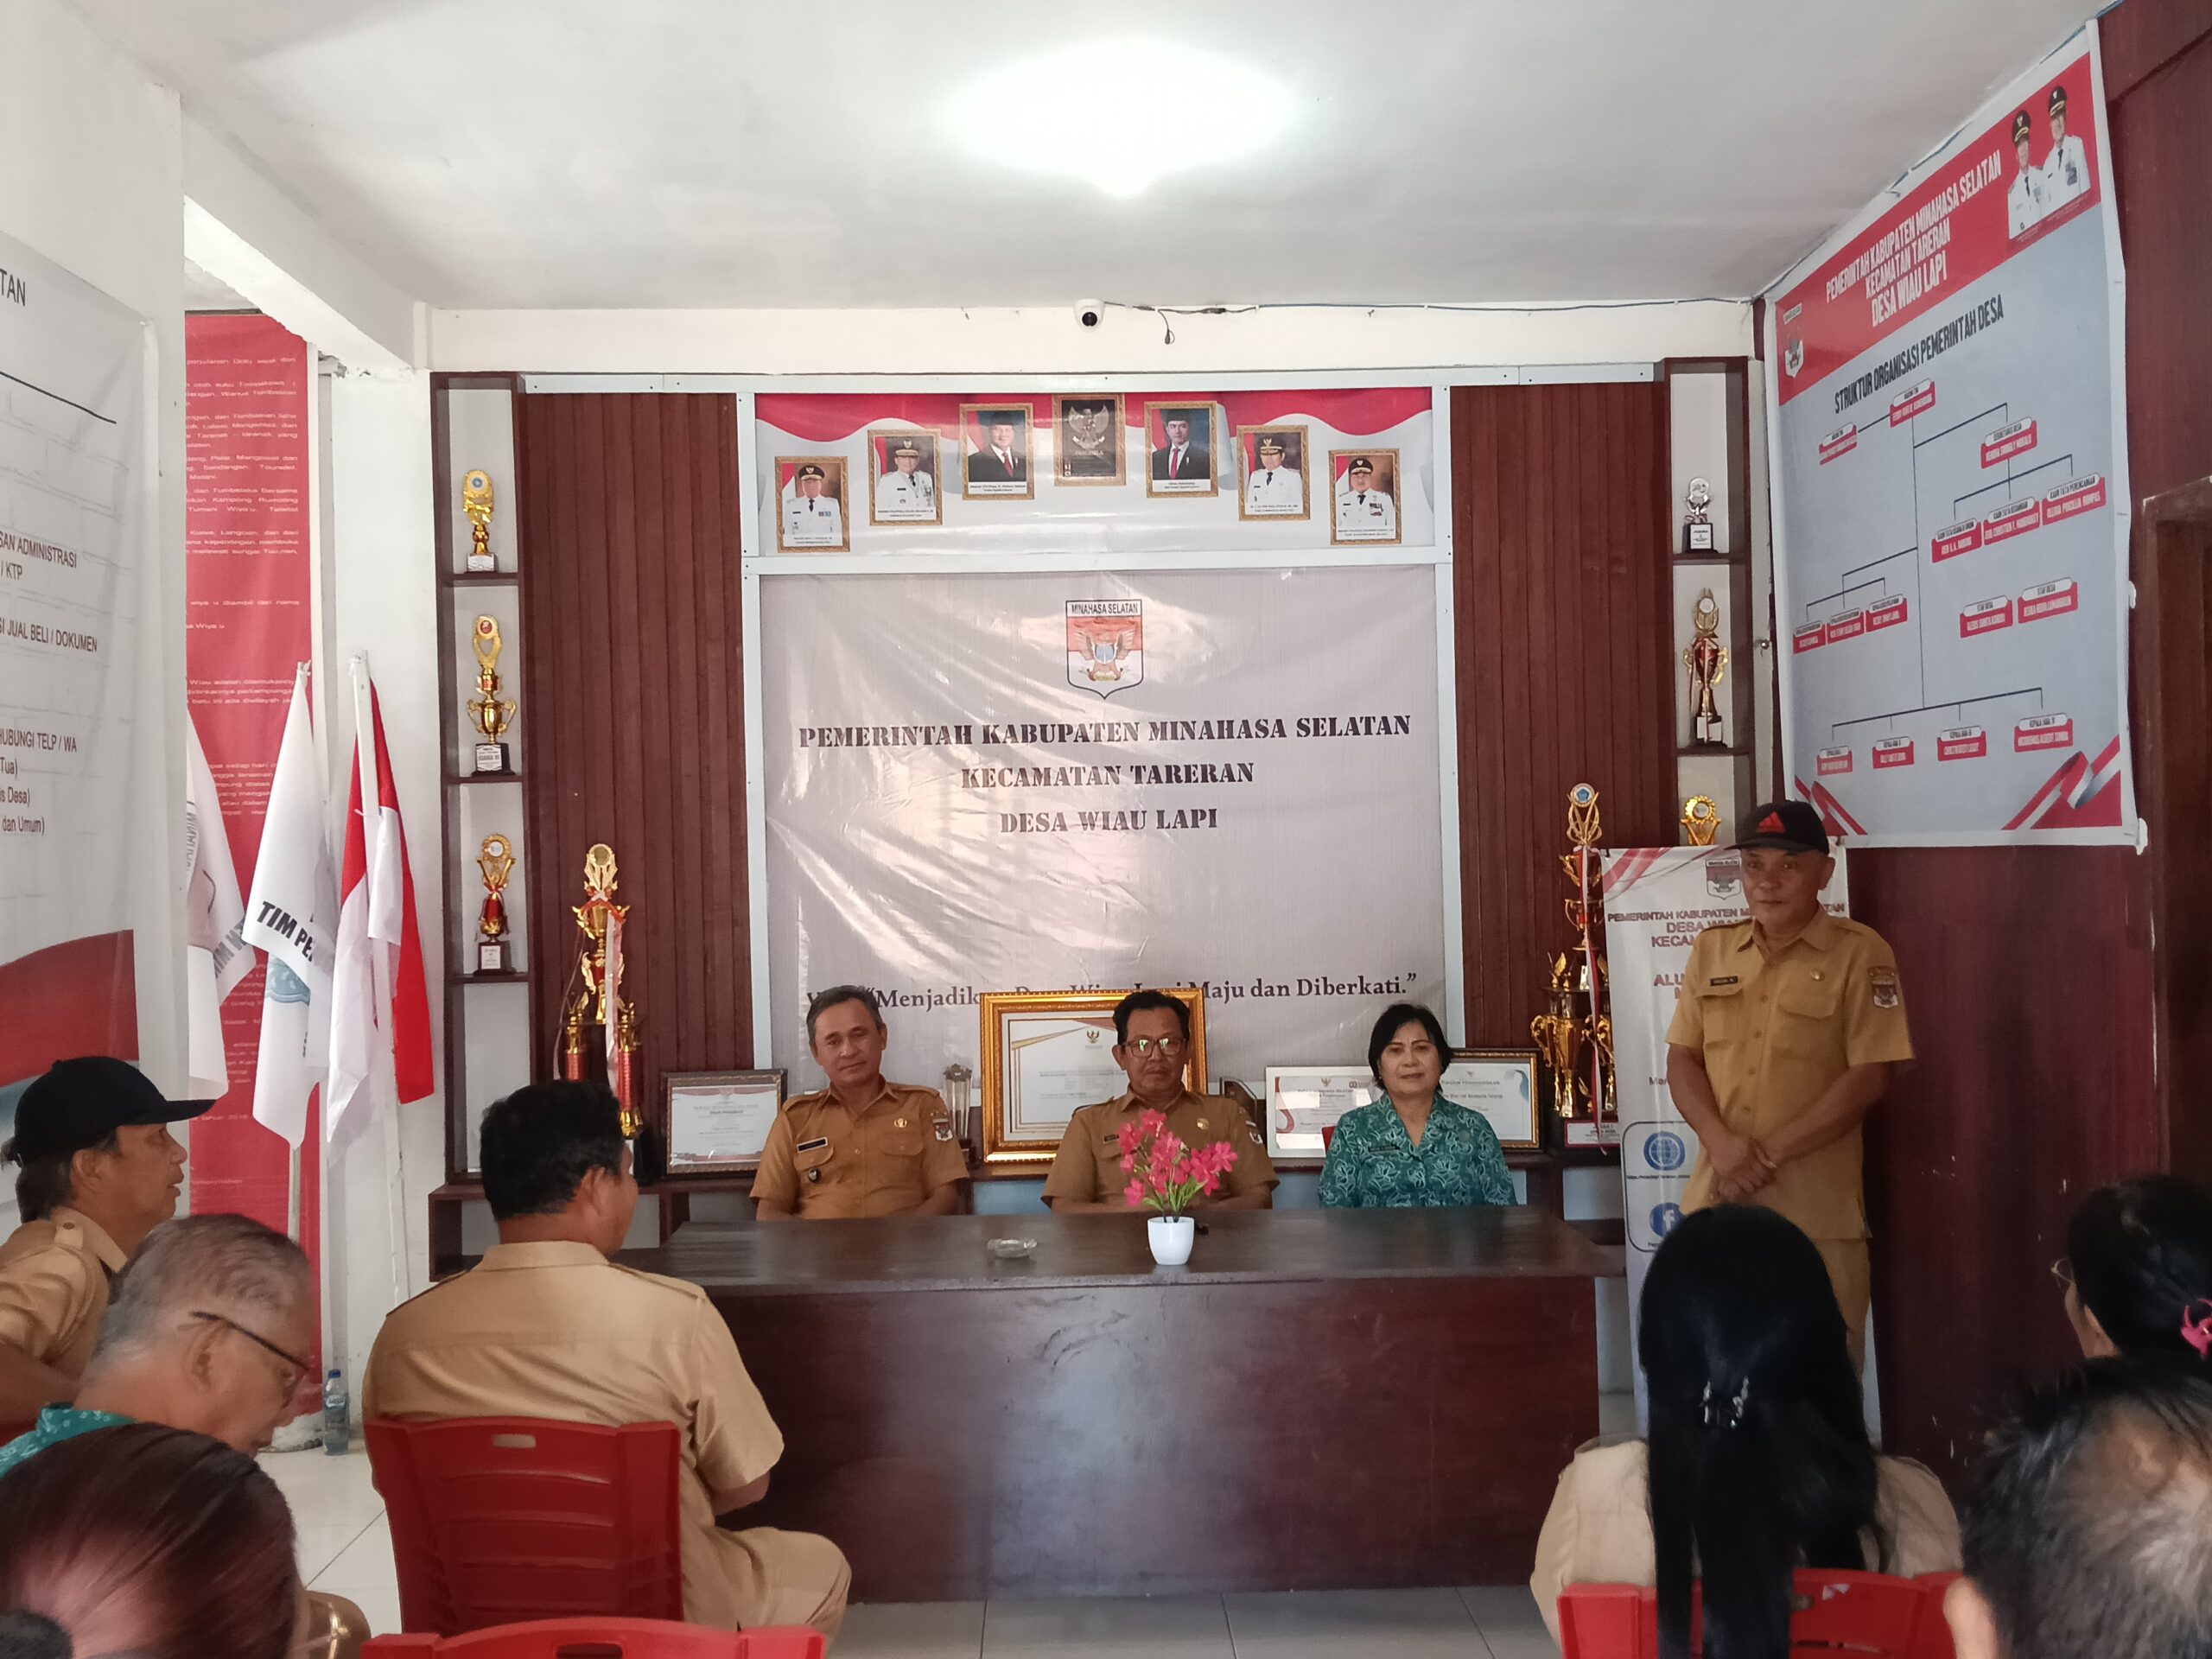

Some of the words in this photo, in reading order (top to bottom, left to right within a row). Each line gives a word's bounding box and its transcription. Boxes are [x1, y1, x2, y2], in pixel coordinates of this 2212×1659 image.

[1826, 251, 1870, 303] PEMERINTAH
[1870, 215, 1916, 270] KABUPATEN
[1916, 183, 1960, 235] MINAHASA
[1960, 149, 2001, 203] SELATAN
[1866, 246, 1911, 299] KECAMATAN
[1912, 217, 1951, 265] TARERAN
[1872, 290, 1897, 327] DESA
[1897, 267, 1923, 309] WIAU
[1923, 250, 1947, 293] LAPI
[1834, 372, 1872, 414] STRUKTUR
[1873, 343, 1920, 391] ORGANISASI
[1920, 309, 1976, 364] PEMERINTAH
[1978, 294, 2004, 331] DESA
[17, 537, 77, 569] ADMINISTRASI
[6, 562, 23, 581] KTP
[1071, 604, 1107, 614] MINAHASA
[1108, 603, 1138, 614] SELATAN
[7, 620, 28, 639] JUAL
[30, 624, 48, 643] BELI
[56, 630, 98, 652] DOKUMEN
[37, 733, 57, 750] TELP
[64, 736, 77, 753] WA
[799, 726, 972, 747] PEMERINTAH
[982, 722, 1139, 744] KABUPATEN
[1149, 719, 1287, 741] MINAHASA
[1297, 715, 1411, 737] SELATAN
[0, 756, 18, 779] Tua)
[962, 766, 1122, 787] KECAMATAN
[1130, 762, 1255, 785] TARERAN
[8, 786, 30, 807] Desa)
[3, 816, 16, 832] dan
[18, 816, 45, 836] Umum)
[1000, 814, 1069, 833] DESA
[1080, 811, 1147, 830] WIAU
[1156, 809, 1217, 829] LAPI
[257, 900, 298, 939] TIM
[1607, 910, 1674, 922] PEMERINTAH
[1676, 908, 1738, 920] KABUPATEN
[1666, 921, 1705, 933] DESA
[865, 987, 981, 1012] “Menjadik
[1250, 978, 1291, 997] dan
[1297, 972, 1417, 997] Diberkati.”
